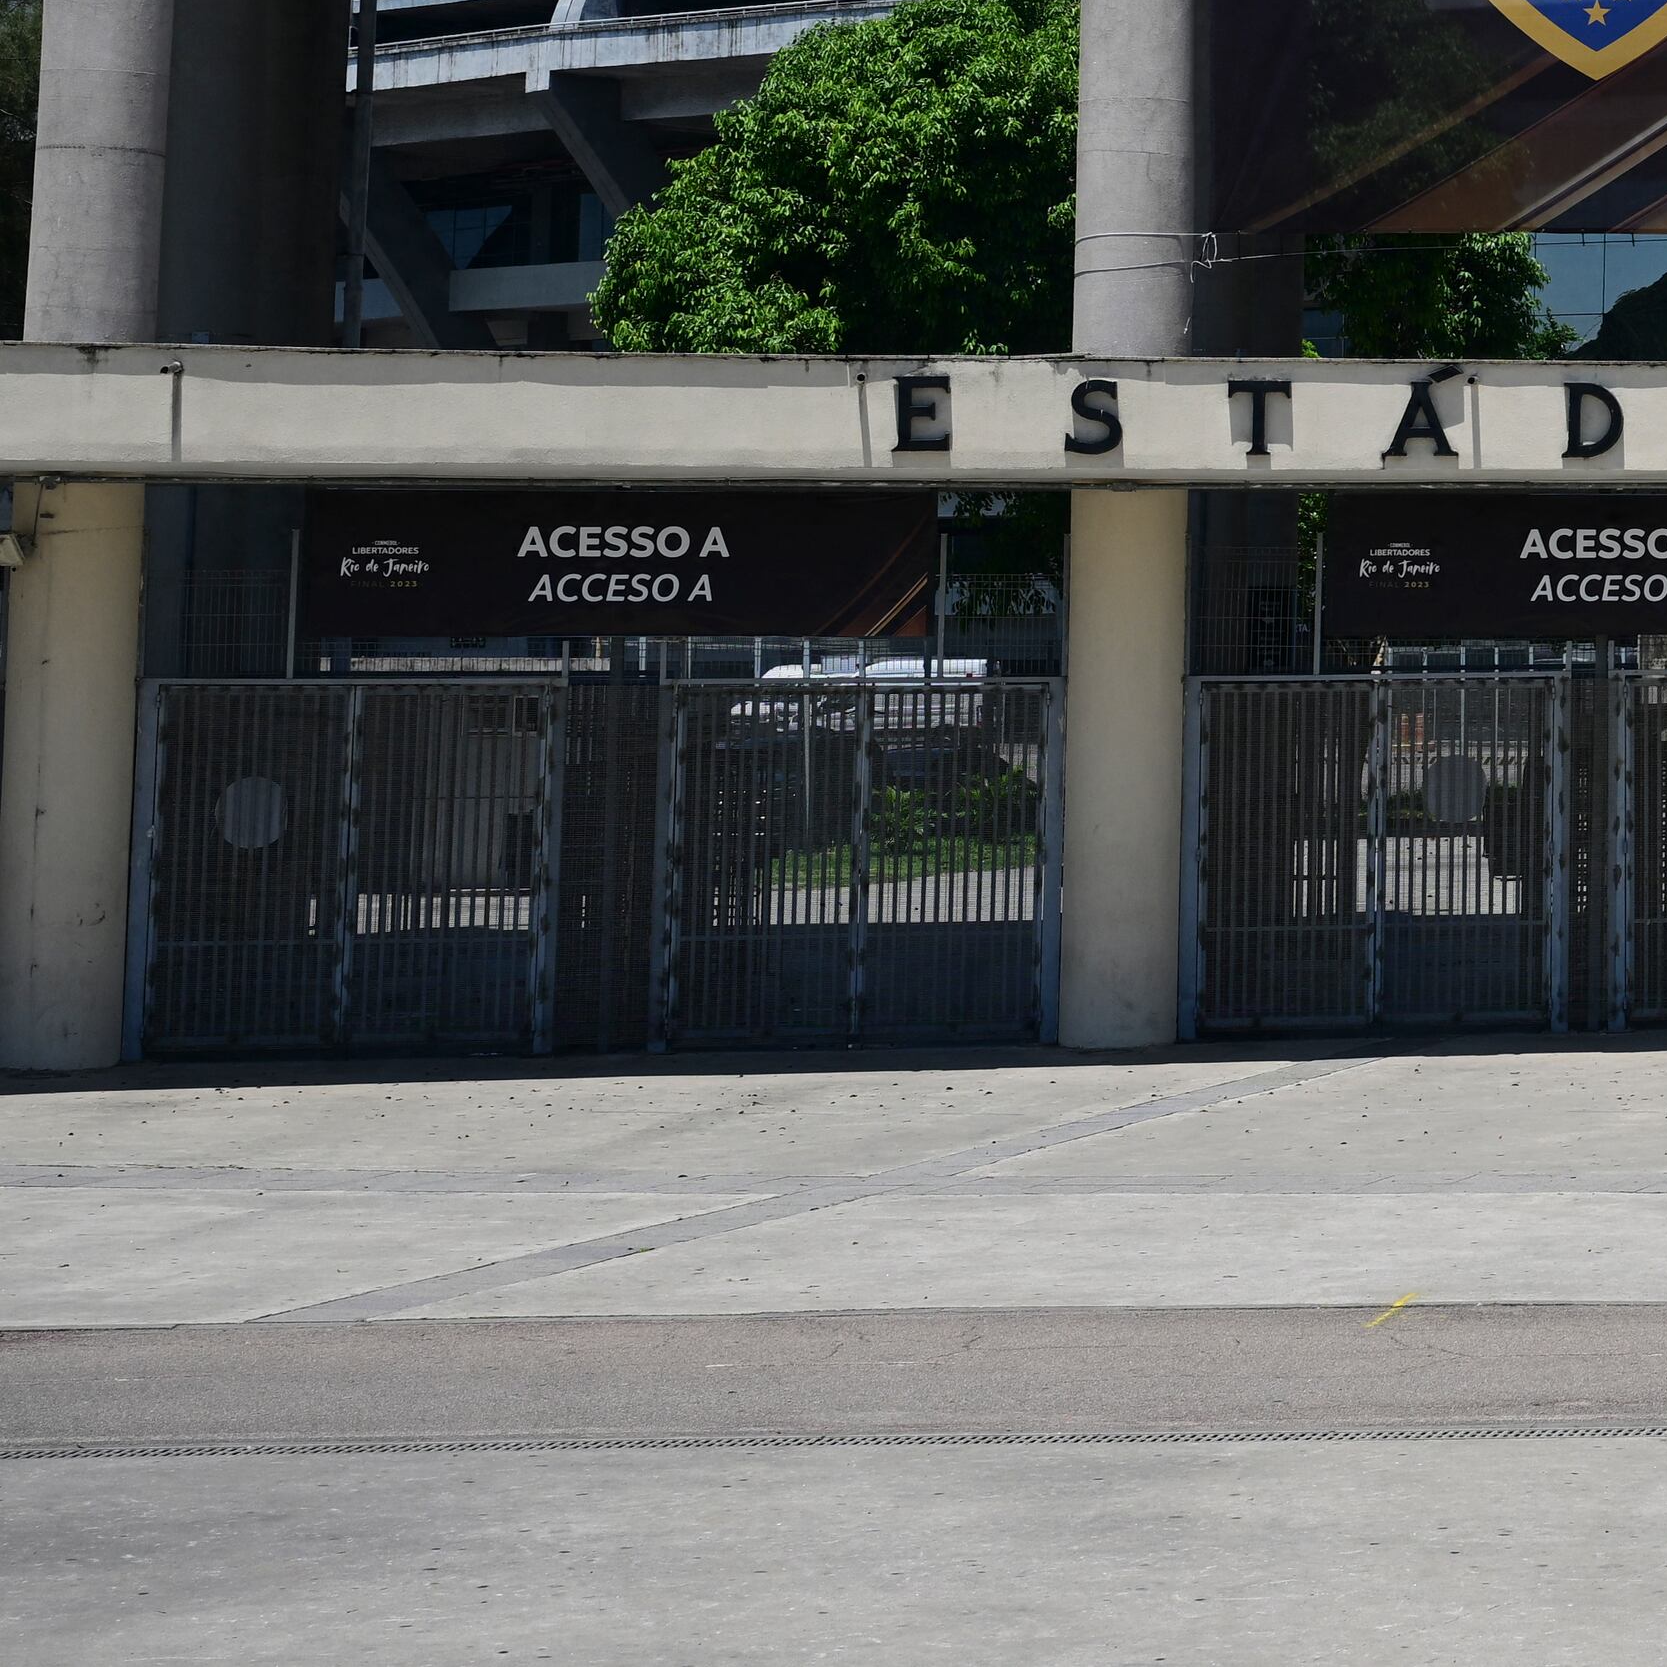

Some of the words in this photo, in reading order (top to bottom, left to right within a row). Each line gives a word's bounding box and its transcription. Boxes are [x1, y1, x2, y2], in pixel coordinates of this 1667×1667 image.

[352, 546, 420, 555] LIBERTADORES
[517, 525, 690, 559] ACESSO
[699, 525, 731, 558] A
[1369, 548, 1431, 556] LIBERTADORES
[340, 556, 360, 577] Rio
[365, 559, 380, 573] de
[382, 557, 430, 577] Janeiro
[1359, 558, 1377, 578] Rio
[1382, 560, 1395, 573] de
[1397, 559, 1441, 578] Janeiro
[390, 580, 418, 588] 2023
[527, 573, 681, 603] ACCESO
[686, 573, 714, 602] A
